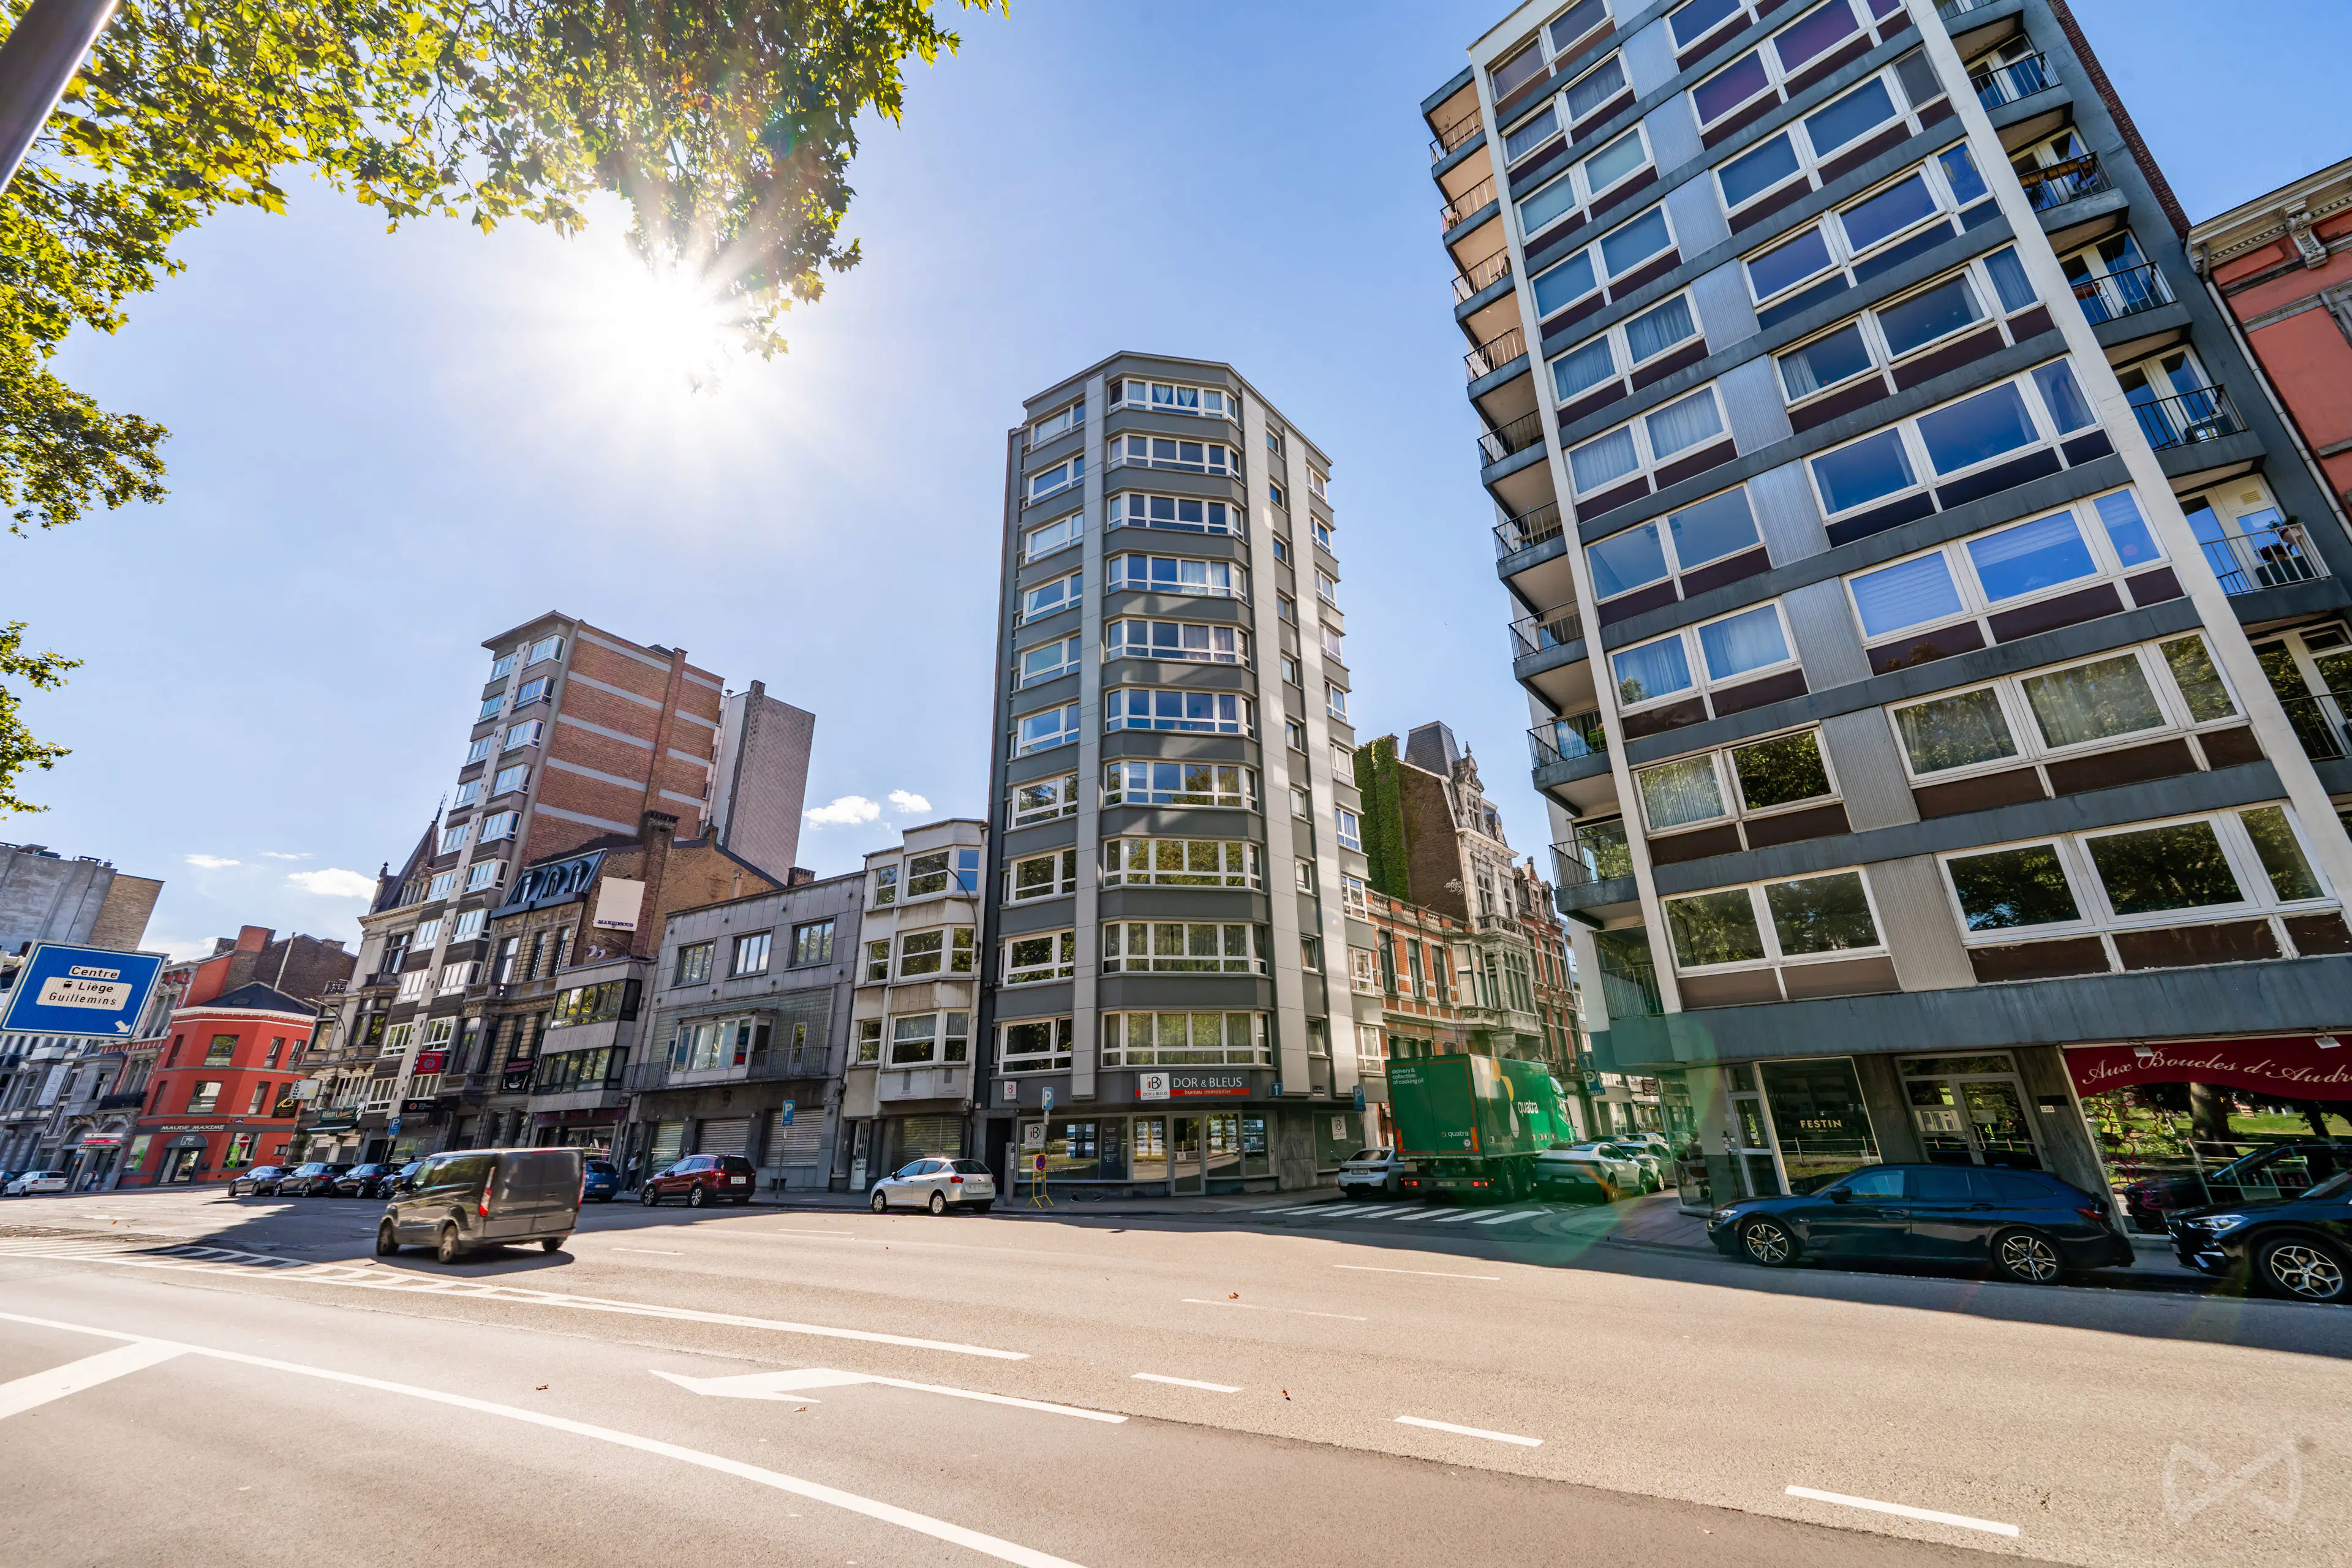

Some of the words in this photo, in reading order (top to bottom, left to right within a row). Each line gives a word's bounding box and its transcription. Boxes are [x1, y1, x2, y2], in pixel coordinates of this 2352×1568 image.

[71, 967, 118, 979] Centre
[78, 982, 114, 994] Liège
[49, 992, 117, 1006] Guillemins
[2082, 1059, 2133, 1084] Aux
[2138, 1047, 2239, 1071] Boucles
[2243, 1059, 2352, 1084] d'Audr
[1173, 1077, 1198, 1088] DOR
[1200, 1079, 1207, 1088] &
[1209, 1077, 1242, 1088] BLEUS
[1583, 1071, 1596, 1090] P
[1044, 1090, 1052, 1107] P
[1354, 1088, 1363, 1102] P
[785, 1103, 793, 1117] P
[1517, 1099, 1539, 1118] quatra
[391, 1118, 400, 1128] P
[1800, 1119, 1842, 1128] FESTIN
